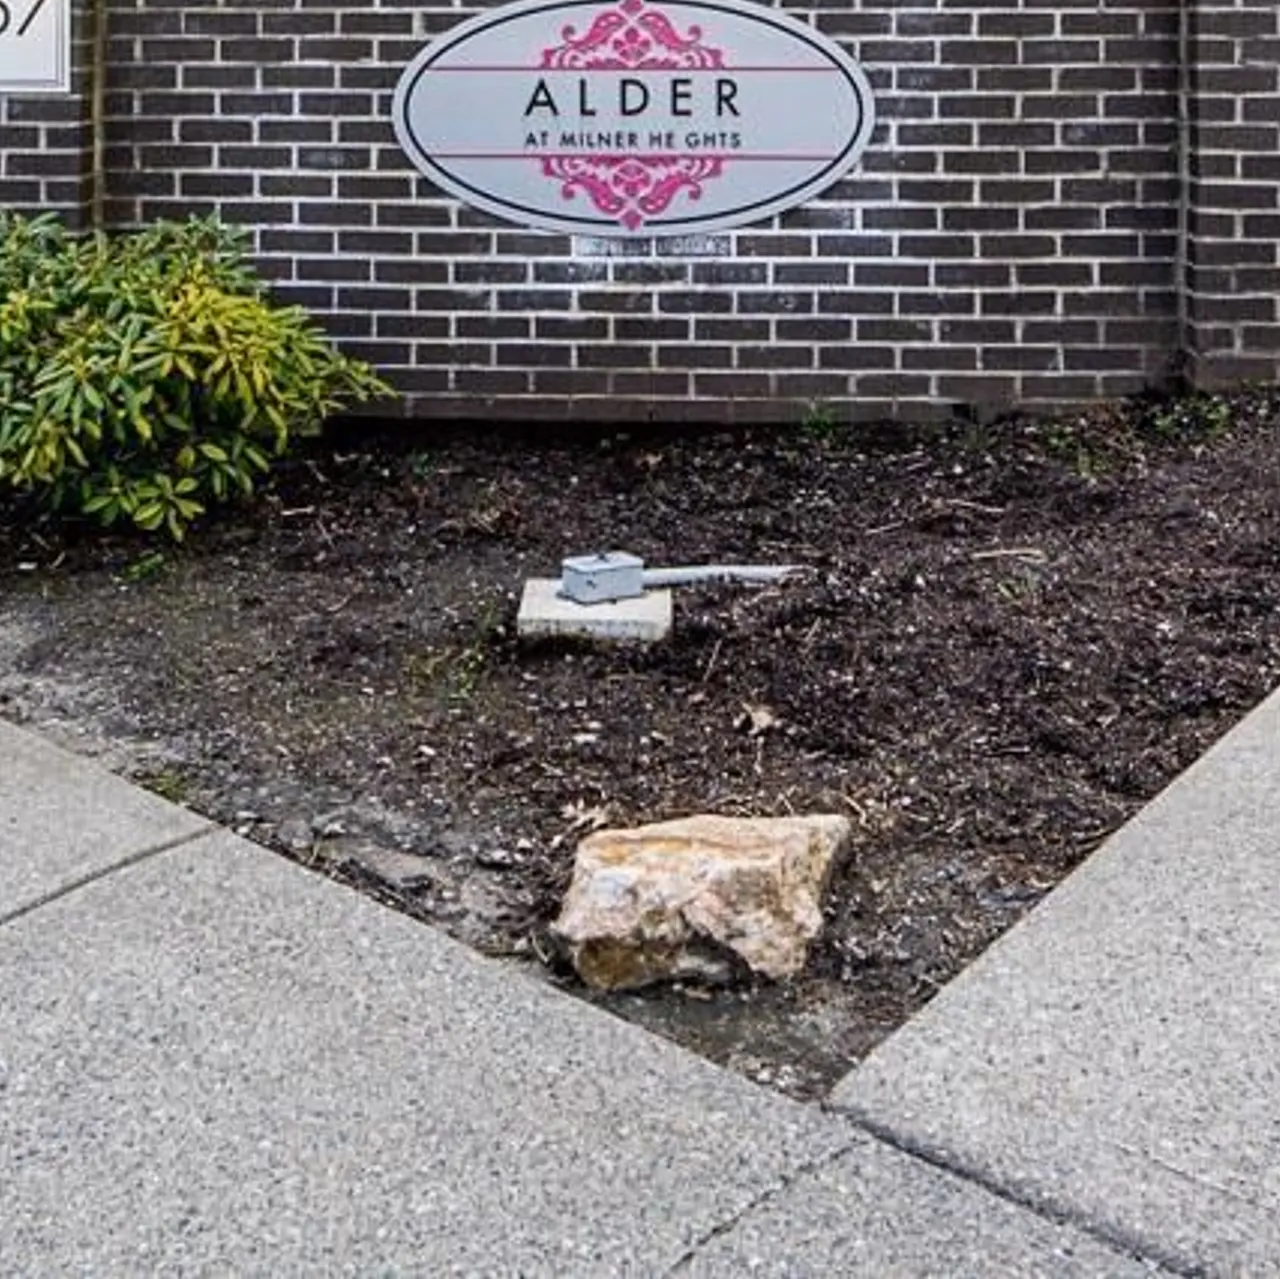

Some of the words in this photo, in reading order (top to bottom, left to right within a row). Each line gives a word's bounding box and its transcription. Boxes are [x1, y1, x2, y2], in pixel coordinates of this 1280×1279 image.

[523, 77, 741, 117] ALDER
[524, 129, 549, 149] AT
[559, 129, 638, 149] MILNER
